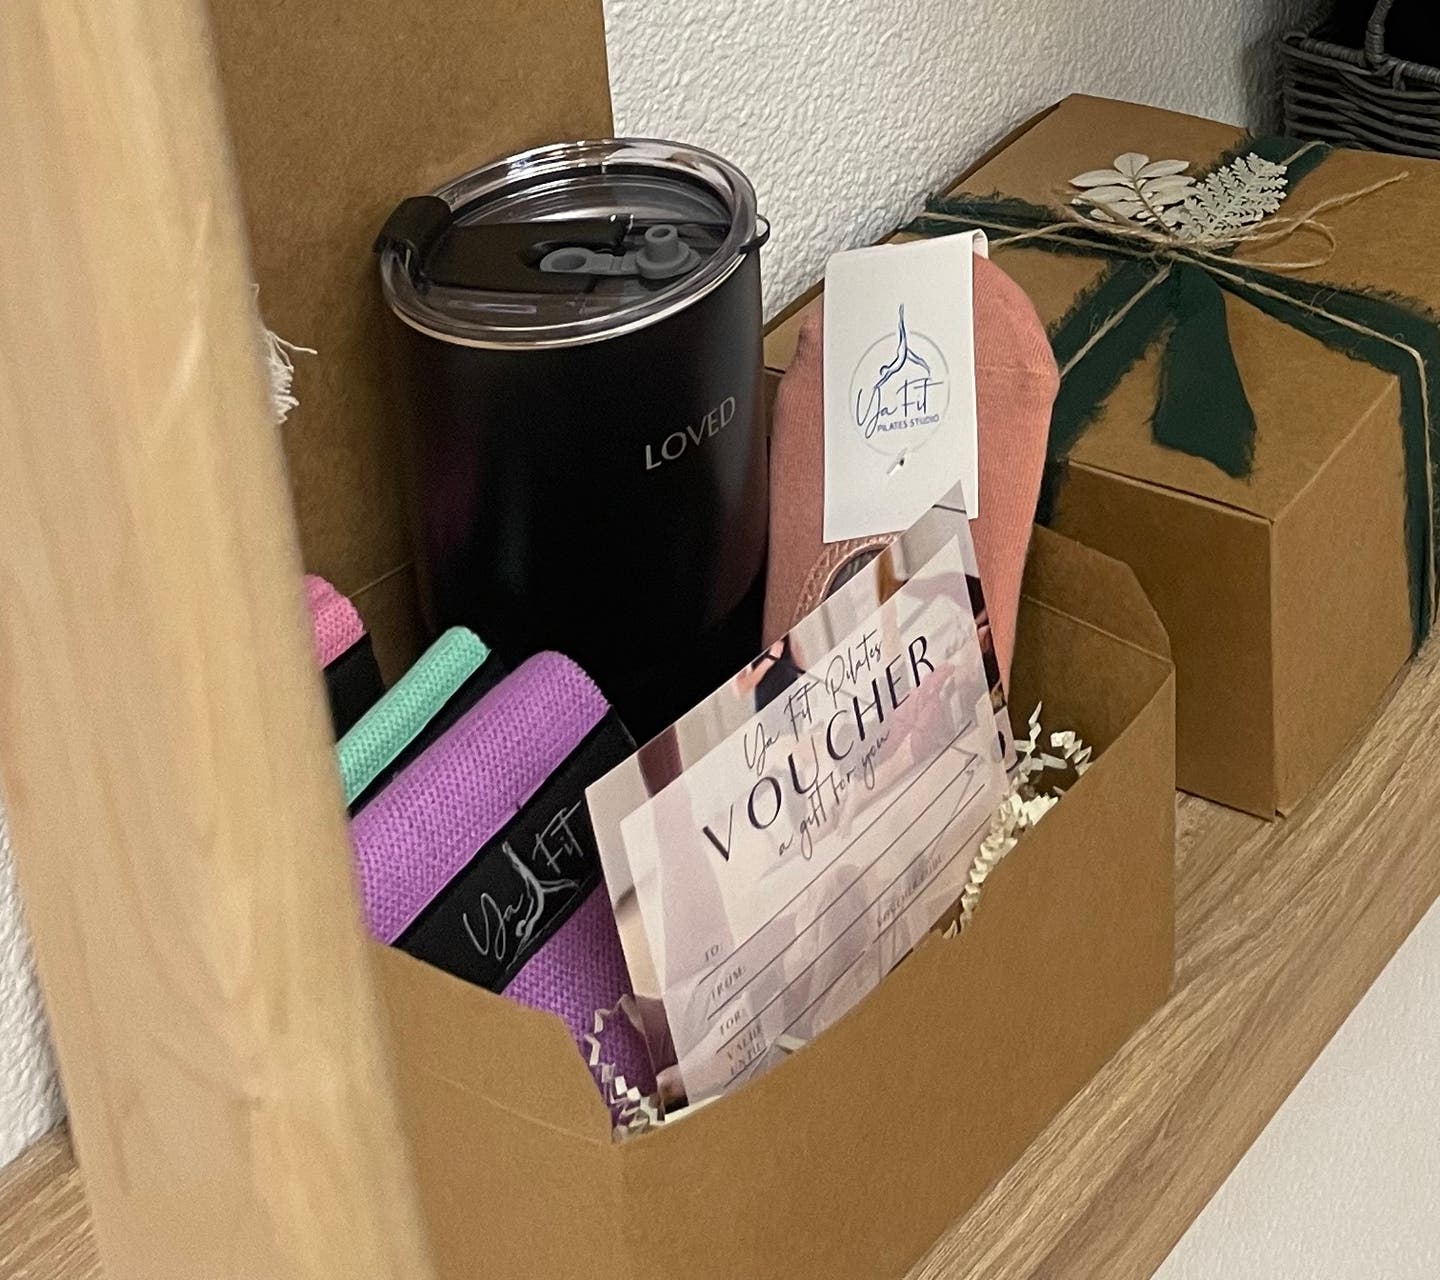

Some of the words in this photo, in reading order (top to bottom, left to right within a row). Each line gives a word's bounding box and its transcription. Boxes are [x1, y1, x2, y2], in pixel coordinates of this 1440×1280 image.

[645, 396, 736, 471] LOVED
[877, 421, 908, 432] PILATES
[910, 413, 940, 428] STUDIO
[702, 635, 935, 862] VOUCHER
